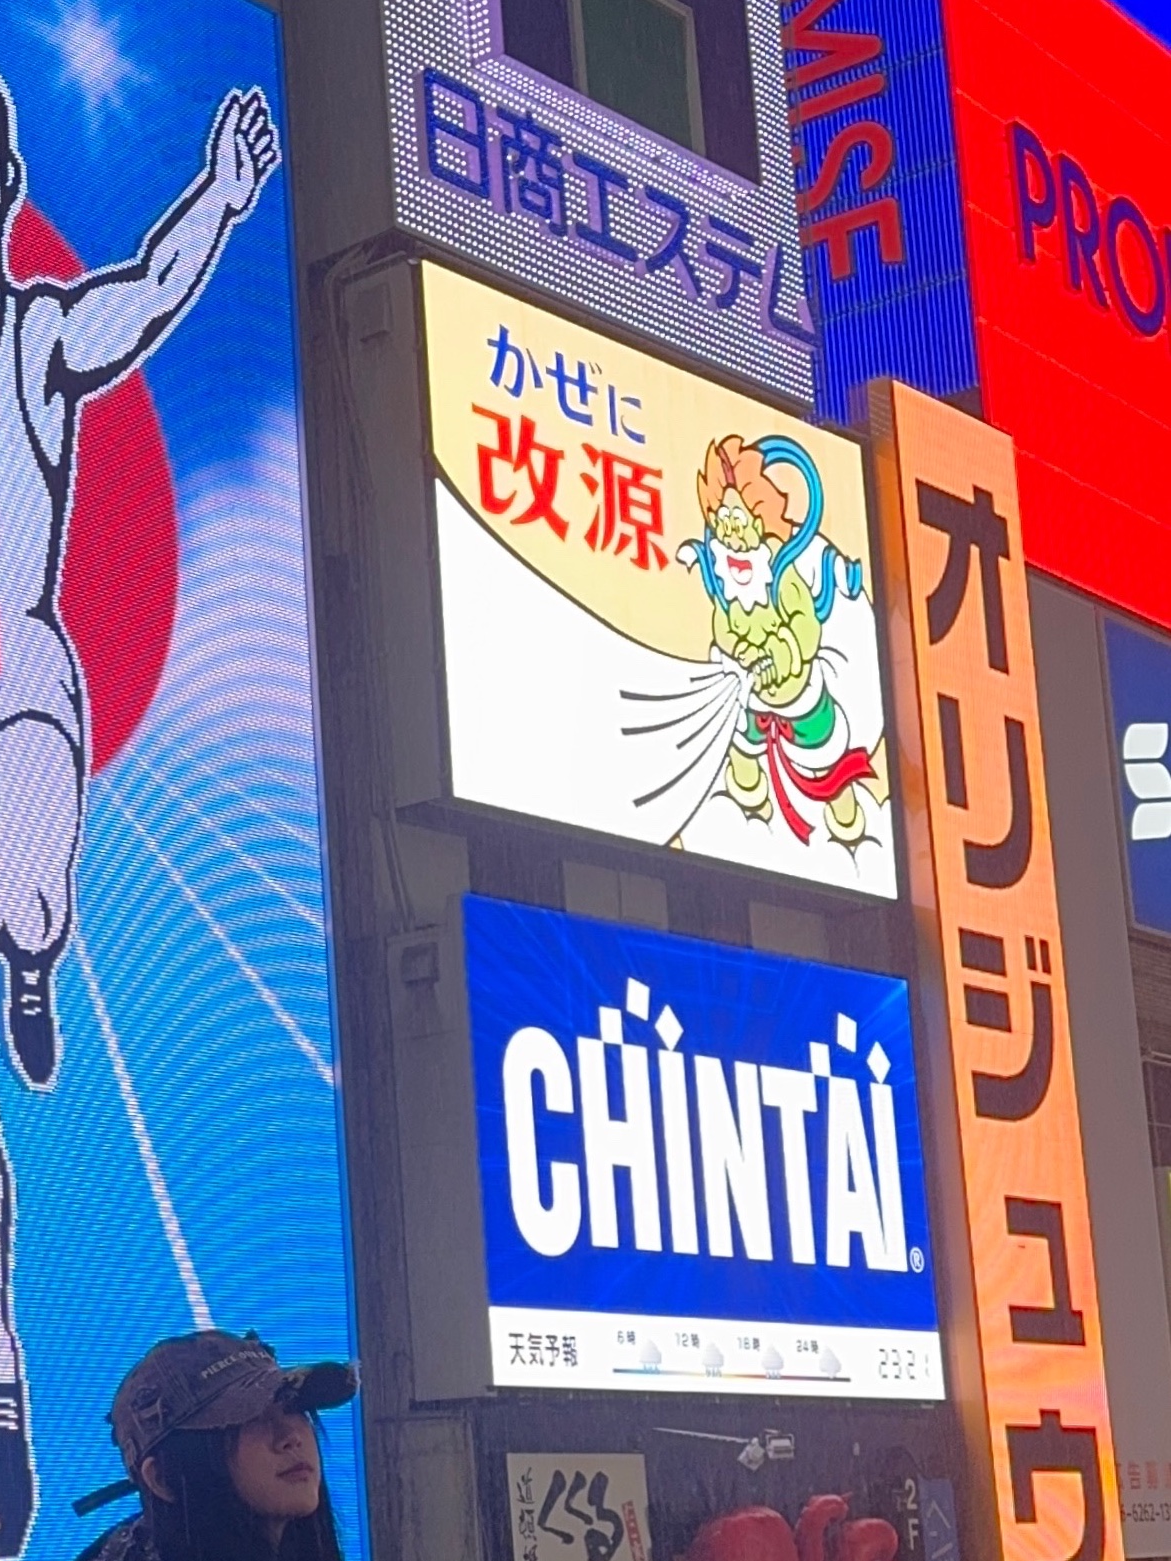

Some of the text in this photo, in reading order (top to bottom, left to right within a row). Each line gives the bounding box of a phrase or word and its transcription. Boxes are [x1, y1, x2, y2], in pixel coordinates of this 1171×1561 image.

[1006, 119, 1171, 338] PRO
[486, 324, 646, 444] かぜに
[471, 403, 671, 572] 改源
[508, 1332, 578, 1367] 天気予報
